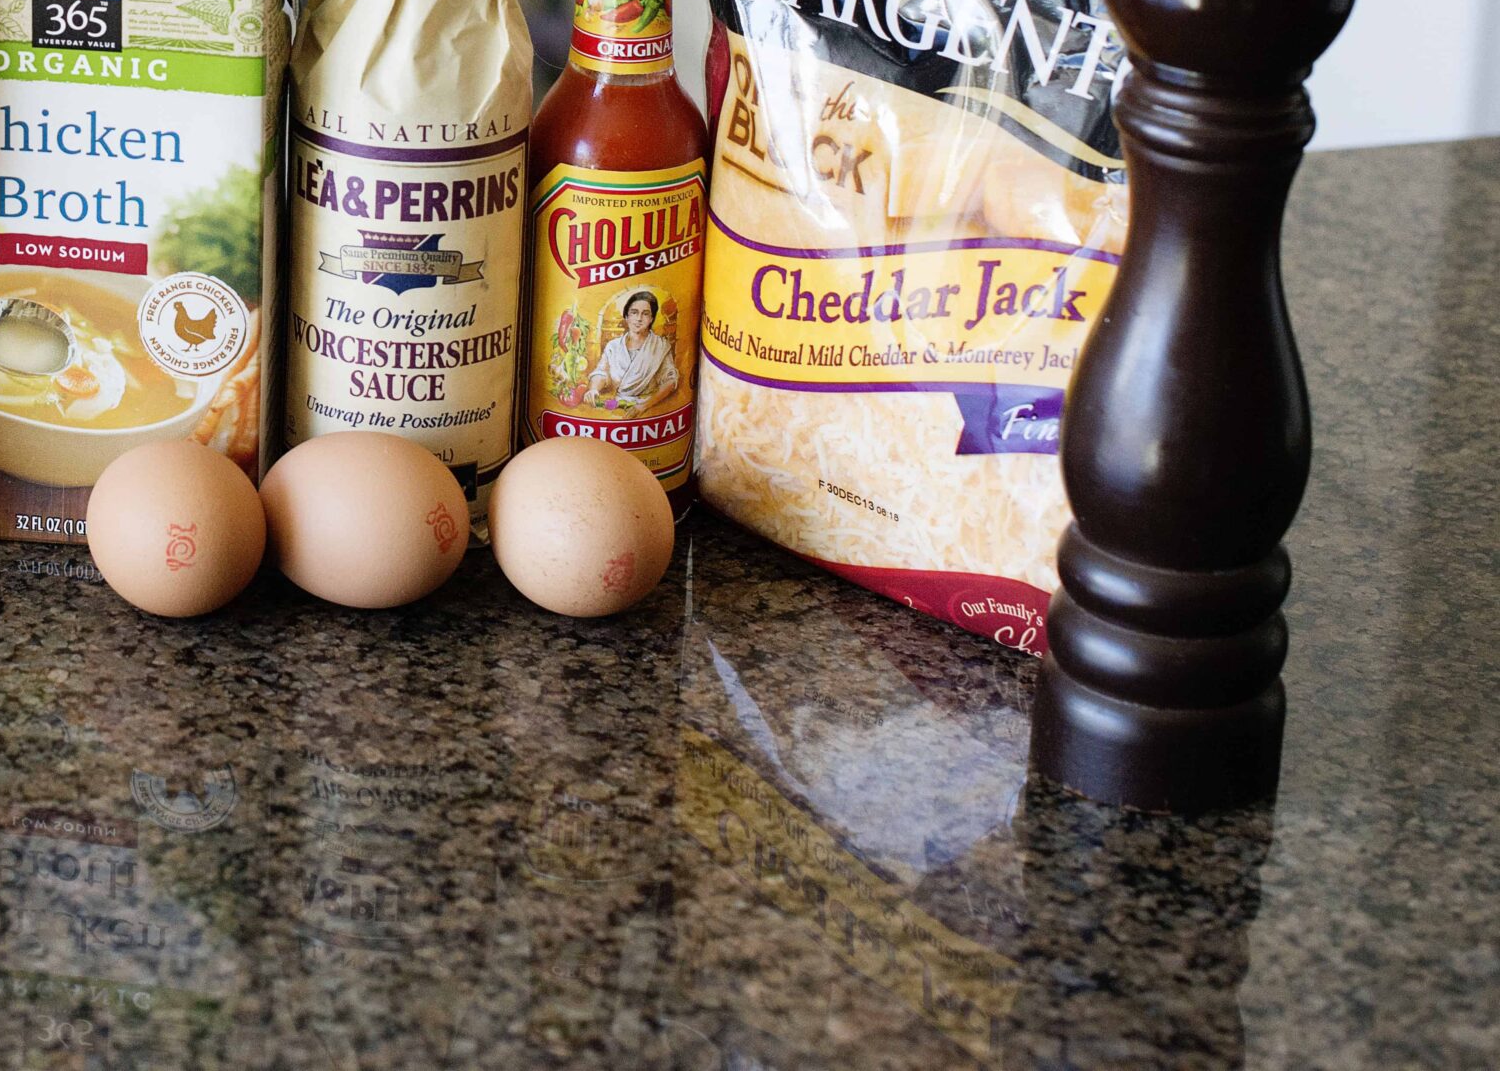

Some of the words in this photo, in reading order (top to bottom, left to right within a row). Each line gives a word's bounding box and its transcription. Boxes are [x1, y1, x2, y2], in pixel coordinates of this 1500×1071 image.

[45, 0, 108, 37] 365
[38, 38, 84, 47] EVERYDAY
[87, 40, 116, 49] VALUE
[306, 105, 348, 134] ALL
[369, 114, 512, 143] NATURAL
[727, 97, 873, 195] BLCK
[297, 155, 338, 212] LEA
[342, 176, 370, 218] &
[375, 167, 518, 222] PERRINS
[572, 194, 627, 208] IMPORTED
[630, 196, 660, 207] FROM
[663, 189, 694, 205] MEXICO
[15, 243, 51, 257] LOW
[58, 245, 125, 263] SODIUM
[548, 196, 702, 280] CHOLULA
[343, 247, 368, 260] Same
[370, 249, 419, 262] Premium
[421, 251, 460, 266] Quality
[363, 260, 402, 273] SINCE
[405, 263, 435, 275] 1835
[589, 261, 637, 283] HOT
[645, 240, 694, 269] SAUCE
[147, 297, 160, 322] FREE
[158, 281, 193, 299] RANGE
[196, 282, 236, 316] CHICKEN
[751, 264, 960, 324] Cheddar
[965, 260, 1087, 331] Jack
[326, 296, 366, 325] The
[373, 304, 477, 338] Original
[149, 337, 190, 369] CHICKEN
[224, 328, 239, 352] FREE
[292, 311, 512, 369] WORCESTERSHIRE
[746, 334, 803, 365] Natural
[807, 344, 844, 367] Mild
[850, 343, 917, 367] Cheddar
[923, 342, 939, 364] &
[945, 341, 1035, 371] Monterey
[193, 351, 227, 370] RANGE
[349, 370, 445, 402] SAUCE
[306, 395, 364, 428] Unwrap
[369, 412, 396, 429] the
[1001, 403, 1060, 441] Fin
[555, 414, 686, 444] ORIGINAL
[818, 479, 825, 488] F
[827, 483, 875, 511] 30DEC13
[16, 515, 29, 529] 32
[31, 516, 43, 531] FL
[46, 517, 60, 532] OZ
[63, 518, 73, 535] (1
[961, 600, 986, 618] Our
[988, 597, 1043, 628] Family's
